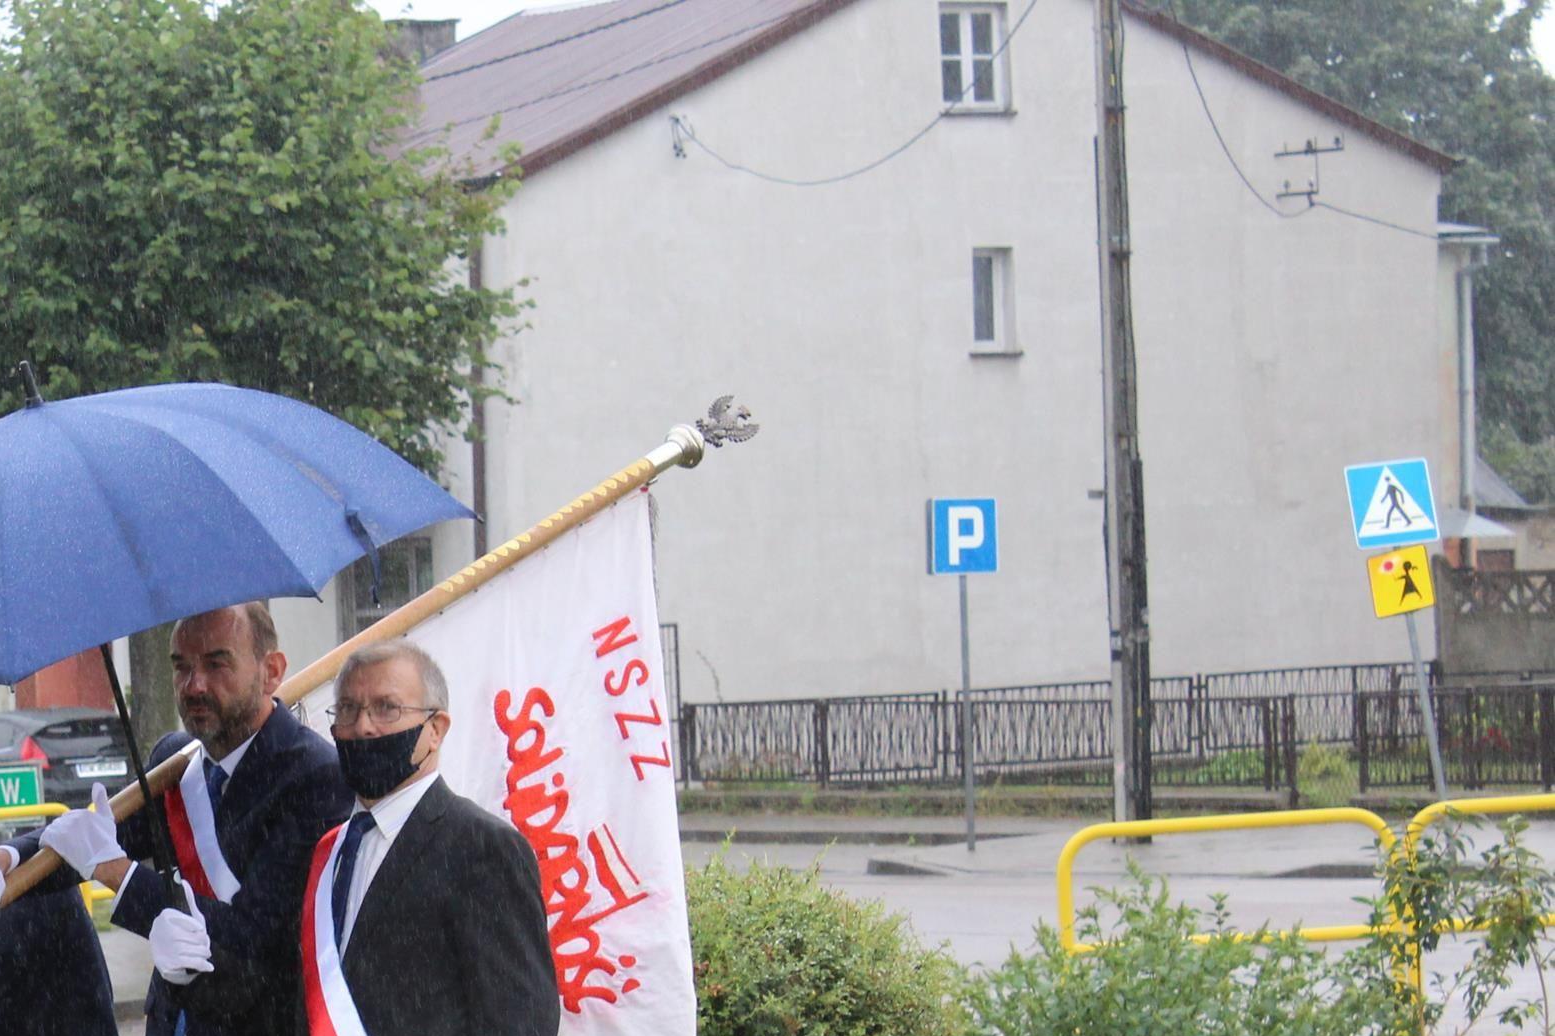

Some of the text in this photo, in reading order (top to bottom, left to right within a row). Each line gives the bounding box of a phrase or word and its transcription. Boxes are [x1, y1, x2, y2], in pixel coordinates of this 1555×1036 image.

[948, 506, 985, 566] P
[592, 615, 671, 782] NSZZ
[0, 777, 26, 805] W.
